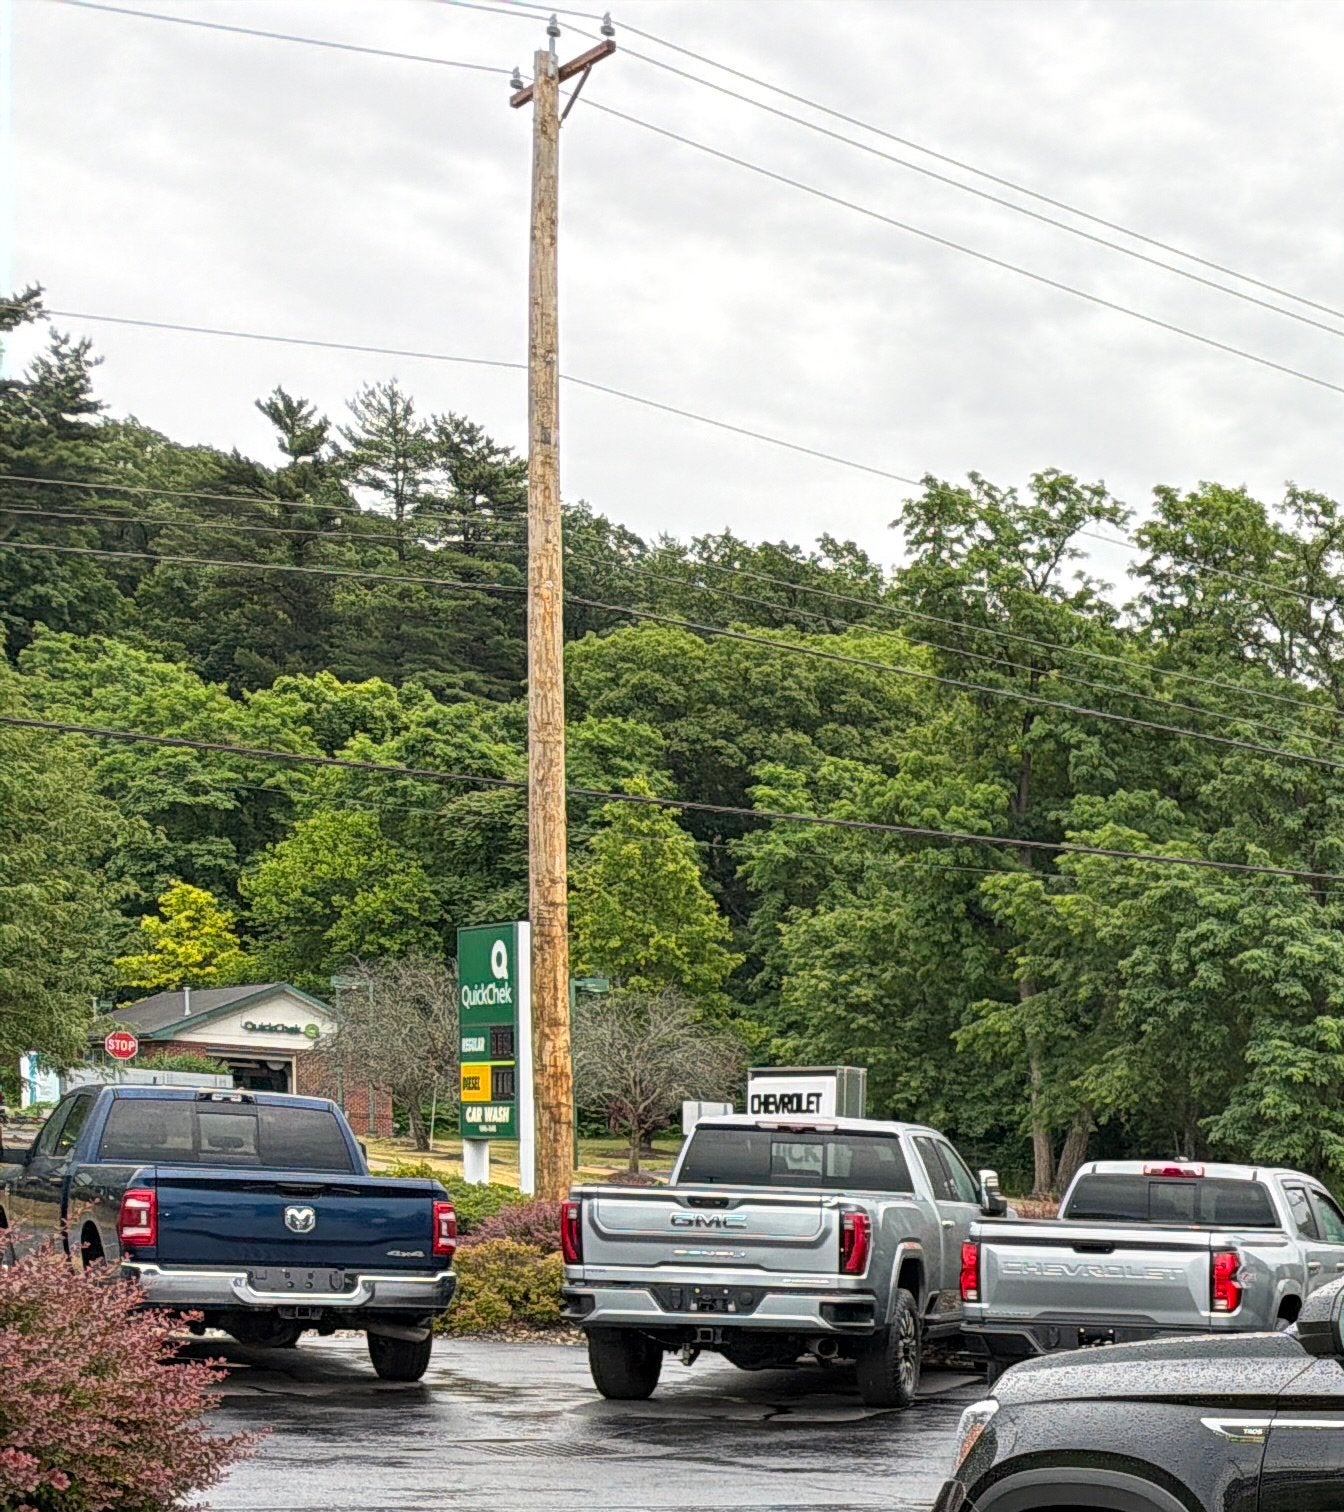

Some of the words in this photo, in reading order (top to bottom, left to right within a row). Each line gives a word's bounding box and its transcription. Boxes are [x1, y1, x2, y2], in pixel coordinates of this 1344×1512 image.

[490, 939, 509, 980] Q
[461, 981, 512, 1009] QuickChek
[107, 1039, 136, 1051] STOP
[462, 1075, 481, 1091] DIESEL
[750, 1092, 823, 1115] CHEVROLET
[465, 1107, 483, 1123] CAR
[484, 1106, 510, 1122] WASH
[669, 1211, 748, 1229] GMC
[1001, 1260, 1184, 1281] CHEVROLET
